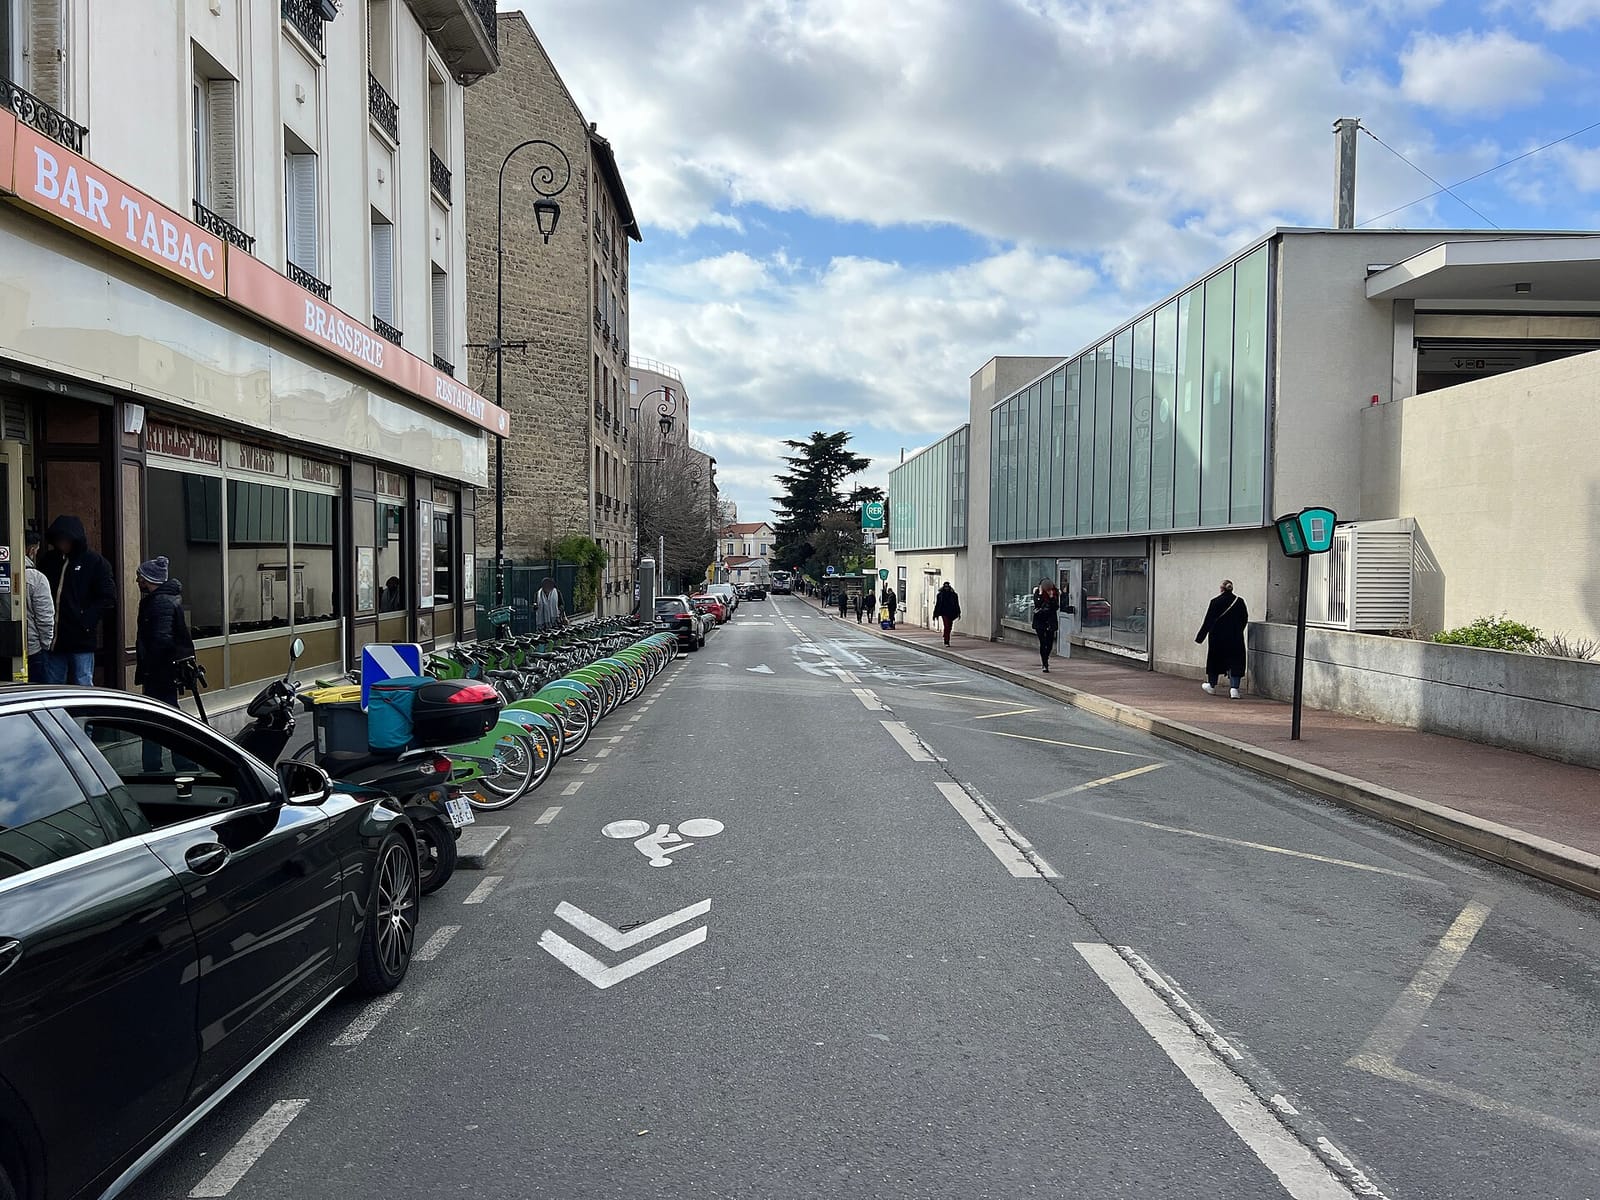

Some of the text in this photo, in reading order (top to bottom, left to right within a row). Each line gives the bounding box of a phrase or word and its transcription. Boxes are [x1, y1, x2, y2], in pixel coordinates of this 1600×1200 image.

[34, 145, 215, 280] BAR TABAC
[304, 299, 384, 369] BRASSERIE
[435, 375, 486, 420] RESTAURANT
[239, 442, 275, 473] SWEETS
[868, 507, 882, 515] RER
